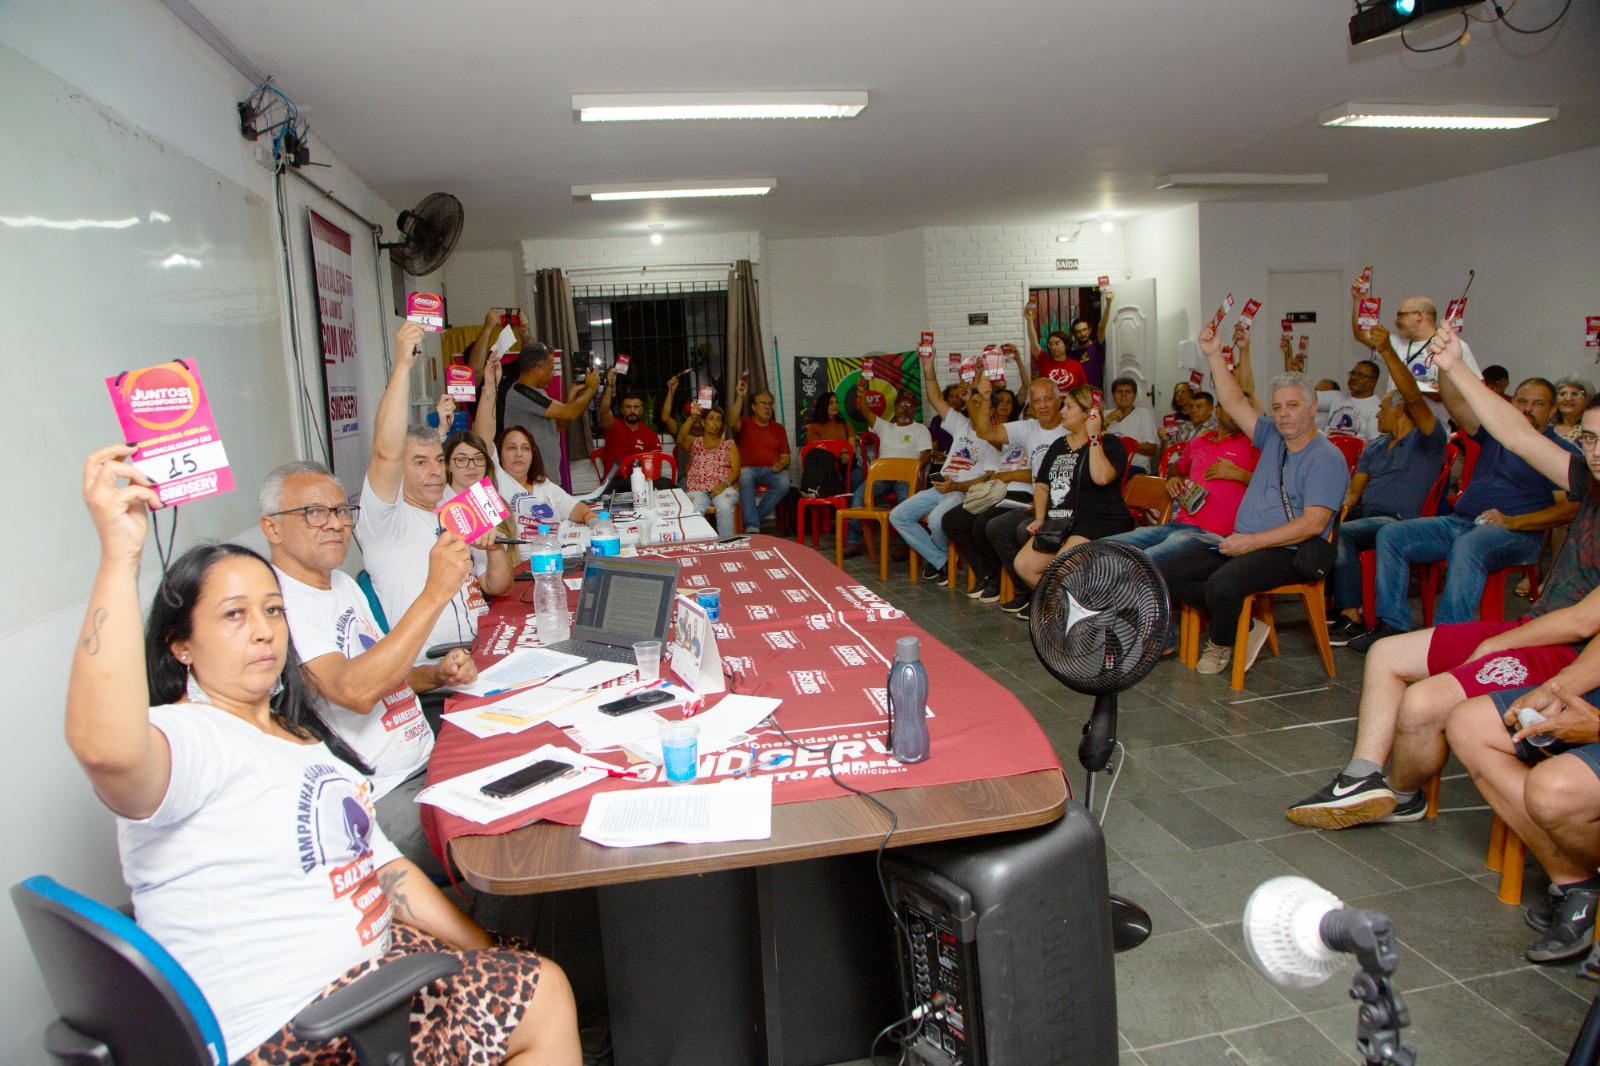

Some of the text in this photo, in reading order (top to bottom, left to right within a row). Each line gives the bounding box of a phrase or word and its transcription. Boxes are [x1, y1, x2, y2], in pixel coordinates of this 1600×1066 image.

[1056, 260, 1078, 269] SAÍDA
[331, 395, 357, 421] SINDSERV
[184, 425, 210, 436] GERAL
[142, 438, 199, 458] SINDICALIZADO
[160, 475, 218, 501] SINDSERV
